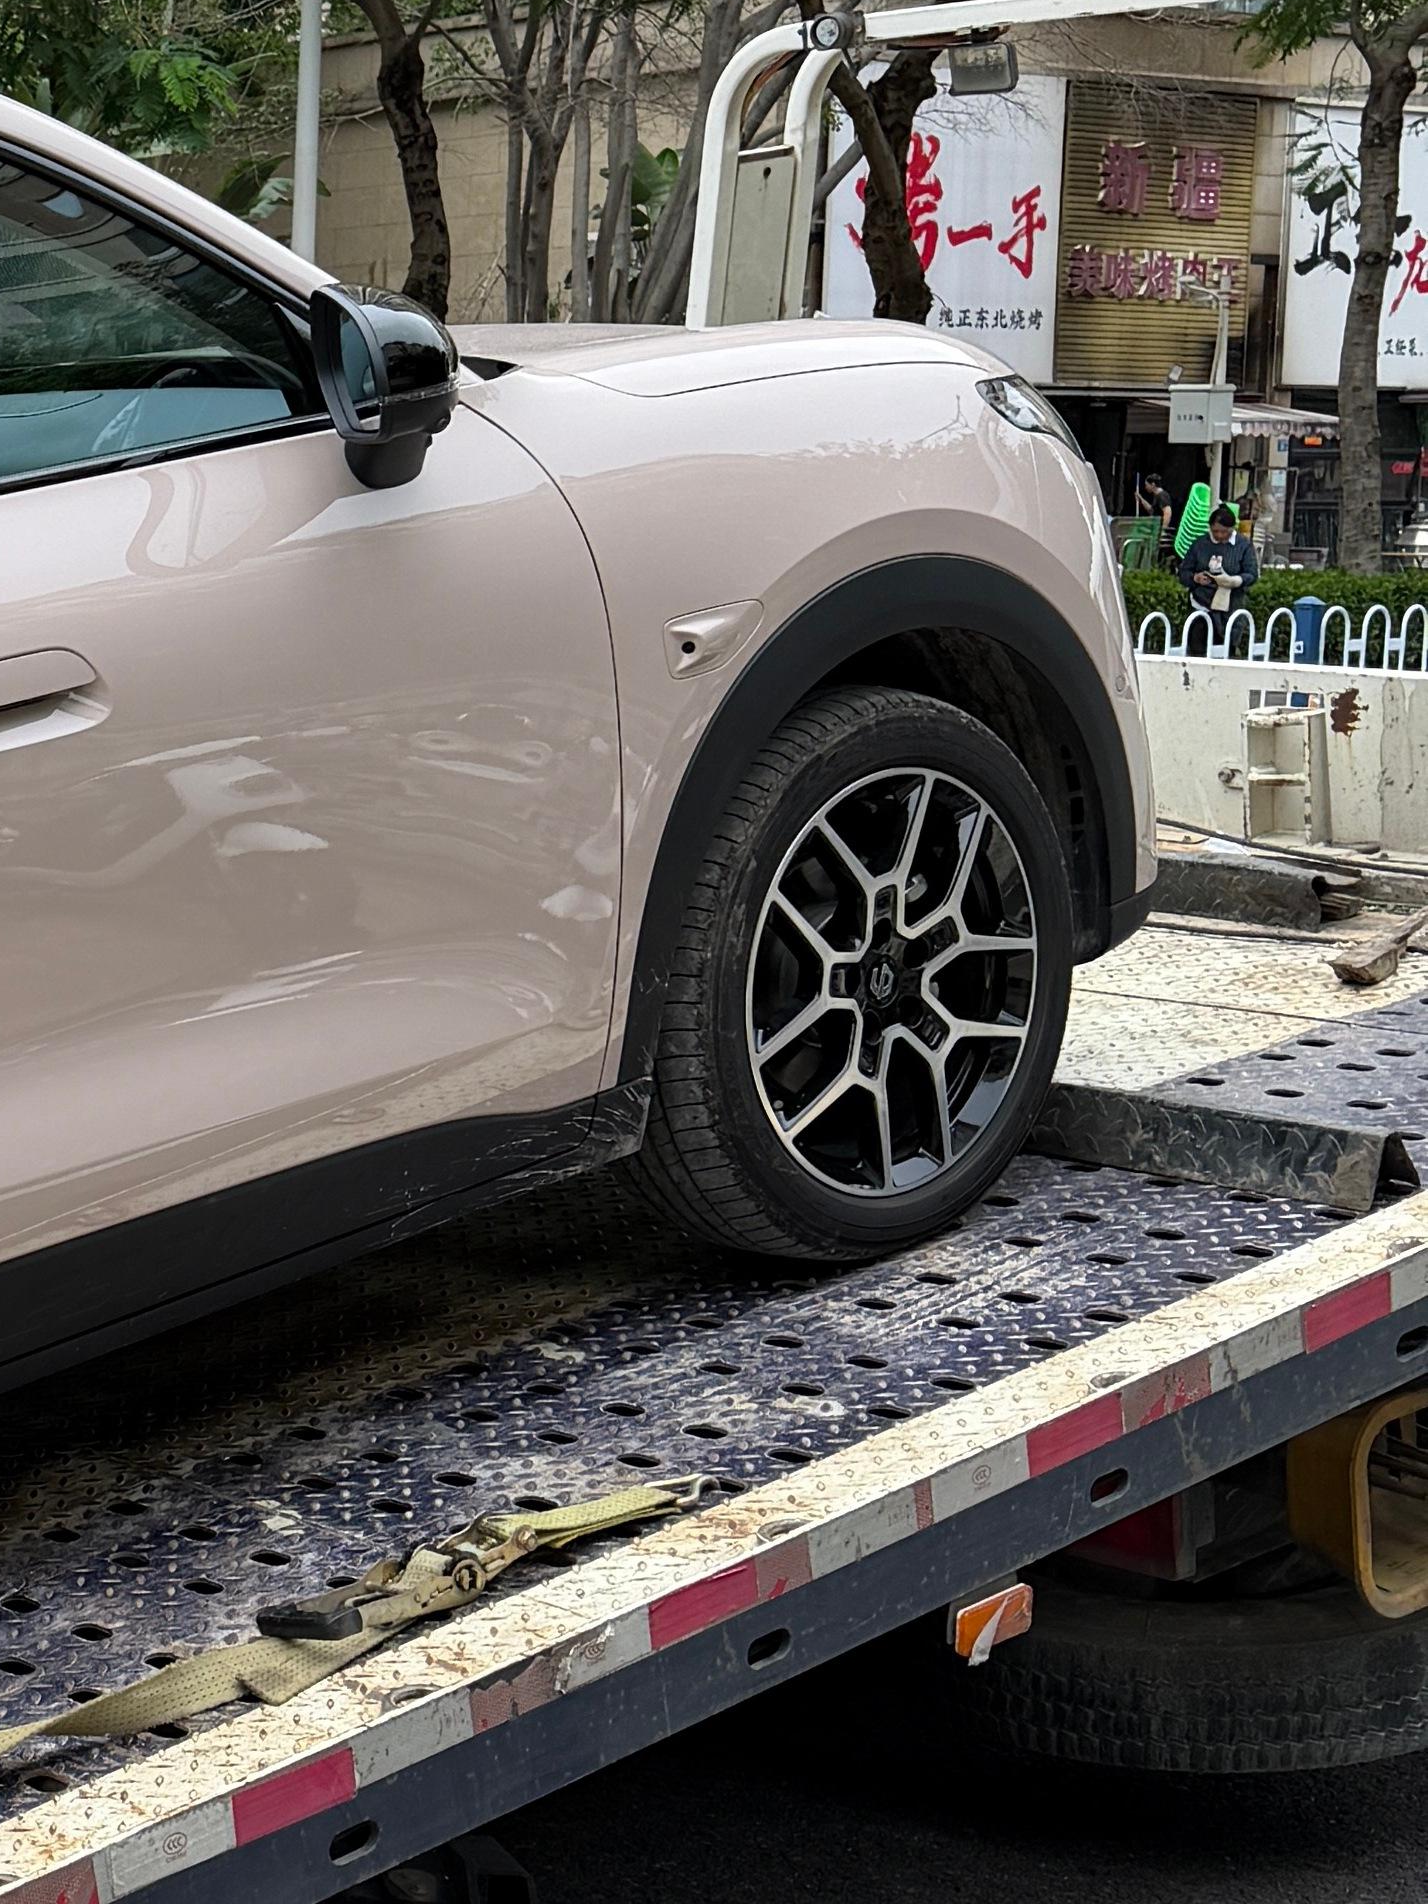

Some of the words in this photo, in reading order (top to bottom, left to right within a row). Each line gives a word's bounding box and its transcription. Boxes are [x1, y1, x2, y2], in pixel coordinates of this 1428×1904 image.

[1098, 136, 1223, 221] 新疆
[938, 307, 1043, 330] 纯正东北烧烤
